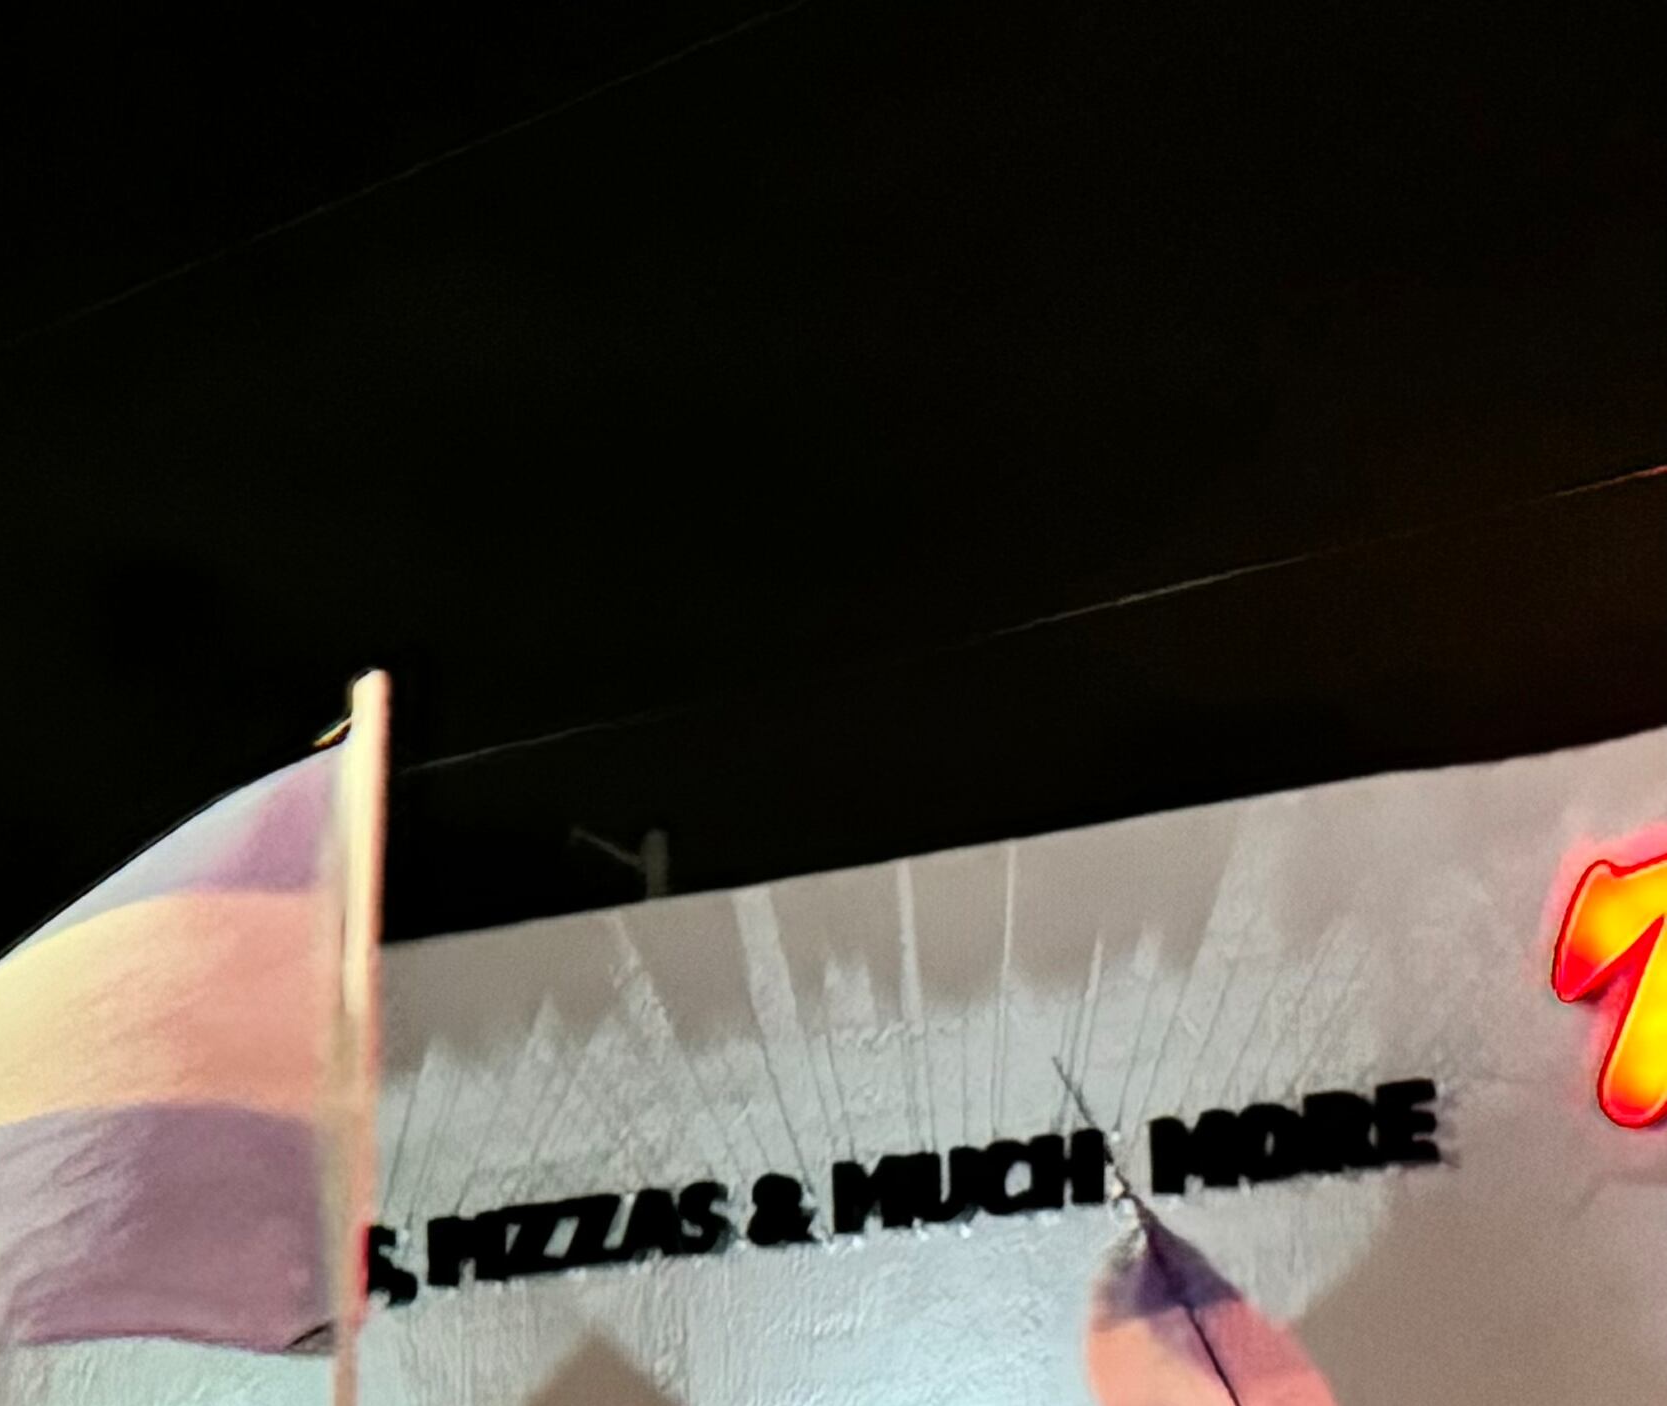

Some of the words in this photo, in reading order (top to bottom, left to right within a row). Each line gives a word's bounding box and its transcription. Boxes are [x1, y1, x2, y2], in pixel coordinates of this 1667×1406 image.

[427, 1181, 734, 1288] PIZZAS
[747, 1172, 815, 1246] &
[832, 1128, 1105, 1234] MUCH
[1149, 1079, 1442, 1195] MORE
